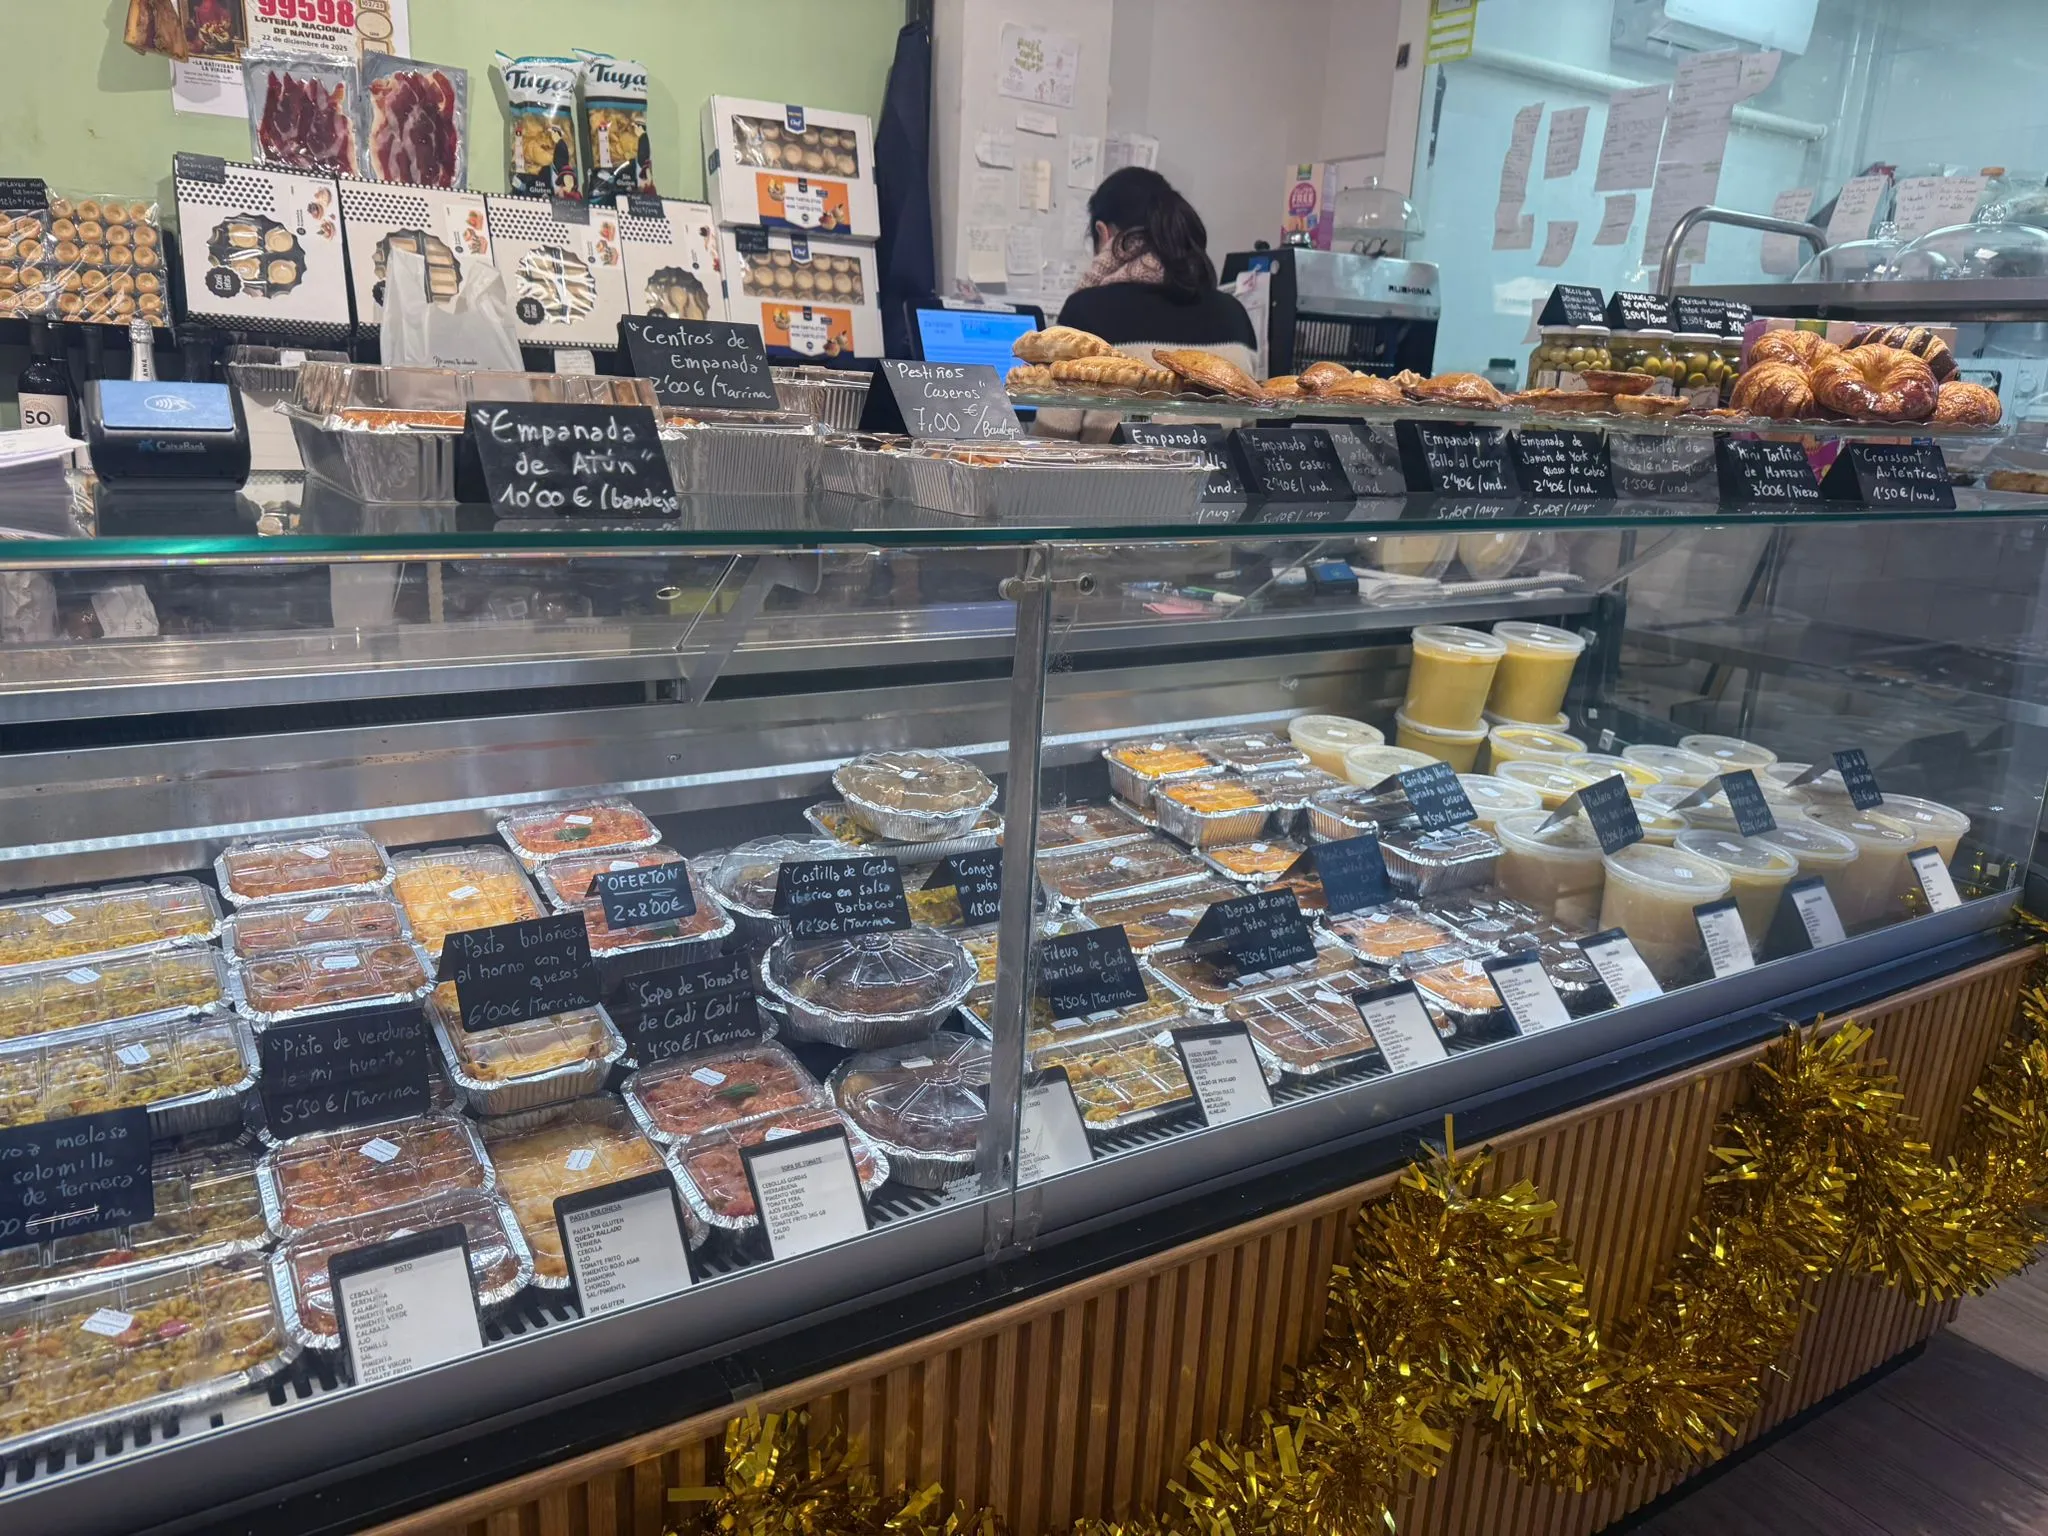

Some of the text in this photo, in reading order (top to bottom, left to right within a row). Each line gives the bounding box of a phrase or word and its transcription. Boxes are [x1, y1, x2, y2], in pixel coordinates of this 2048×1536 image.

[258, 0, 354, 27] 99598
[255, 15, 353, 35] LOTERÍA NACIONAL
[273, 27, 336, 42] DE NAVIDAD
[284, 37, 318, 48] diciembre
[331, 44, 348, 52] 2025
[529, 185, 551, 193] Gluten
[727, 329, 749, 349] de
[671, 354, 763, 374] Empanada"
[25, 411, 51, 425] 50
[1132, 429, 1207, 447] Empanada
[1572, 434, 1583, 448] de
[156, 441, 207, 451] CaixaBank
[515, 452, 549, 475] de
[1428, 453, 1502, 473] Pollo al Curry
[1555, 451, 1566, 462] de
[1568, 449, 1589, 463] York
[1264, 456, 1293, 472] Pisto
[1744, 463, 1758, 477] de
[844, 865, 856, 877] de
[863, 860, 895, 876] Cerdo
[837, 889, 852, 897] en
[860, 880, 890, 895] salsa
[977, 879, 998, 893] salsa
[1258, 896, 1268, 909] de
[520, 924, 585, 948] boloñesa
[1087, 938, 1099, 951] de
[457, 946, 577, 983] al horno con 4
[1044, 963, 1084, 980] Marisco
[1090, 960, 1102, 969] de
[678, 976, 695, 996] de
[697, 961, 750, 990] Tomate
[639, 1013, 658, 1032] de
[664, 1001, 697, 1028] Cadi
[333, 1028, 351, 1050] de
[358, 1020, 421, 1044] verduras
[311, 1063, 332, 1083] mi
[13, 1152, 113, 1184] solomillo
[762, 1180, 786, 1188] CEBOLLAS
[23, 1187, 47, 1206] de
[767, 1200, 787, 1208] TOMATE
[570, 1213, 589, 1222] PASTA
[602, 1218, 624, 1228] GLUTEN
[772, 1219, 792, 1227] TOMATE
[575, 1226, 622, 1242] QUESO RALLADO
[576, 1239, 602, 1249] TERNERA
[578, 1246, 602, 1256] CEBOLLA
[394, 1264, 412, 1273] PISTO
[581, 1255, 621, 1269] TOMATE FRITO
[582, 1267, 608, 1276] PIMIENTO
[610, 1261, 625, 1269] ROJO
[584, 1271, 615, 1284] ZANAHORIA
[585, 1281, 610, 1292] CHORIZO
[601, 1299, 625, 1309] GLUTEN
[388, 1311, 407, 1321] VERDE
[358, 1337, 371, 1346] AJO
[364, 1358, 412, 1377] ACEITE VIRGEN
